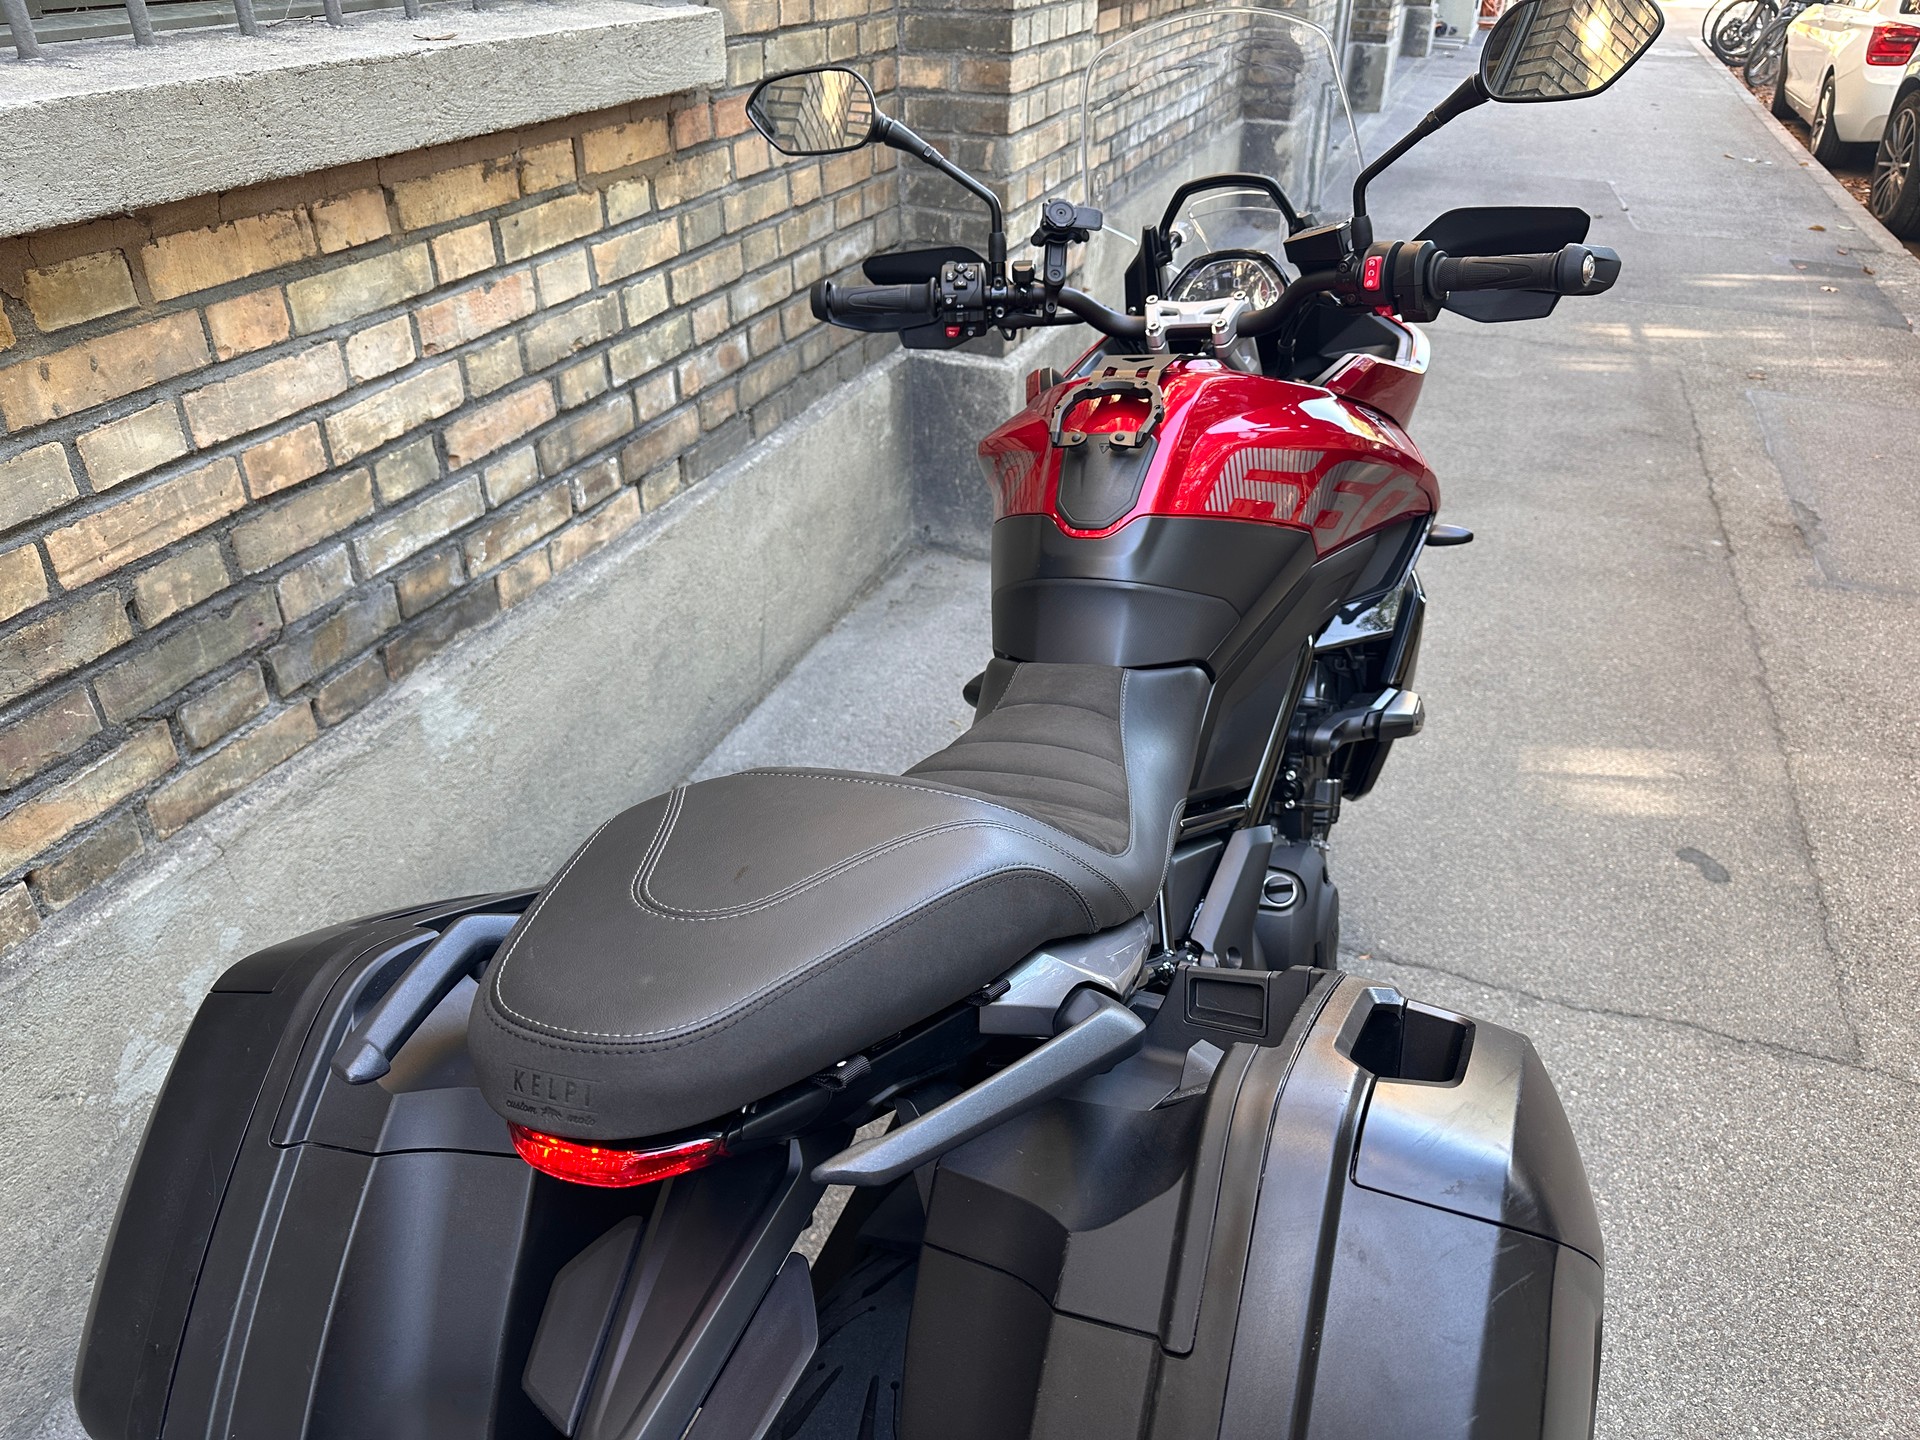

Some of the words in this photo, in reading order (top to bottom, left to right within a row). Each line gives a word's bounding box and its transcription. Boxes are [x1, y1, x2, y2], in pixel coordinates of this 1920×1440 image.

[1204, 447, 1431, 550] 660
[506, 1099, 537, 1115] custom
[513, 1069, 592, 1107] KELPI
